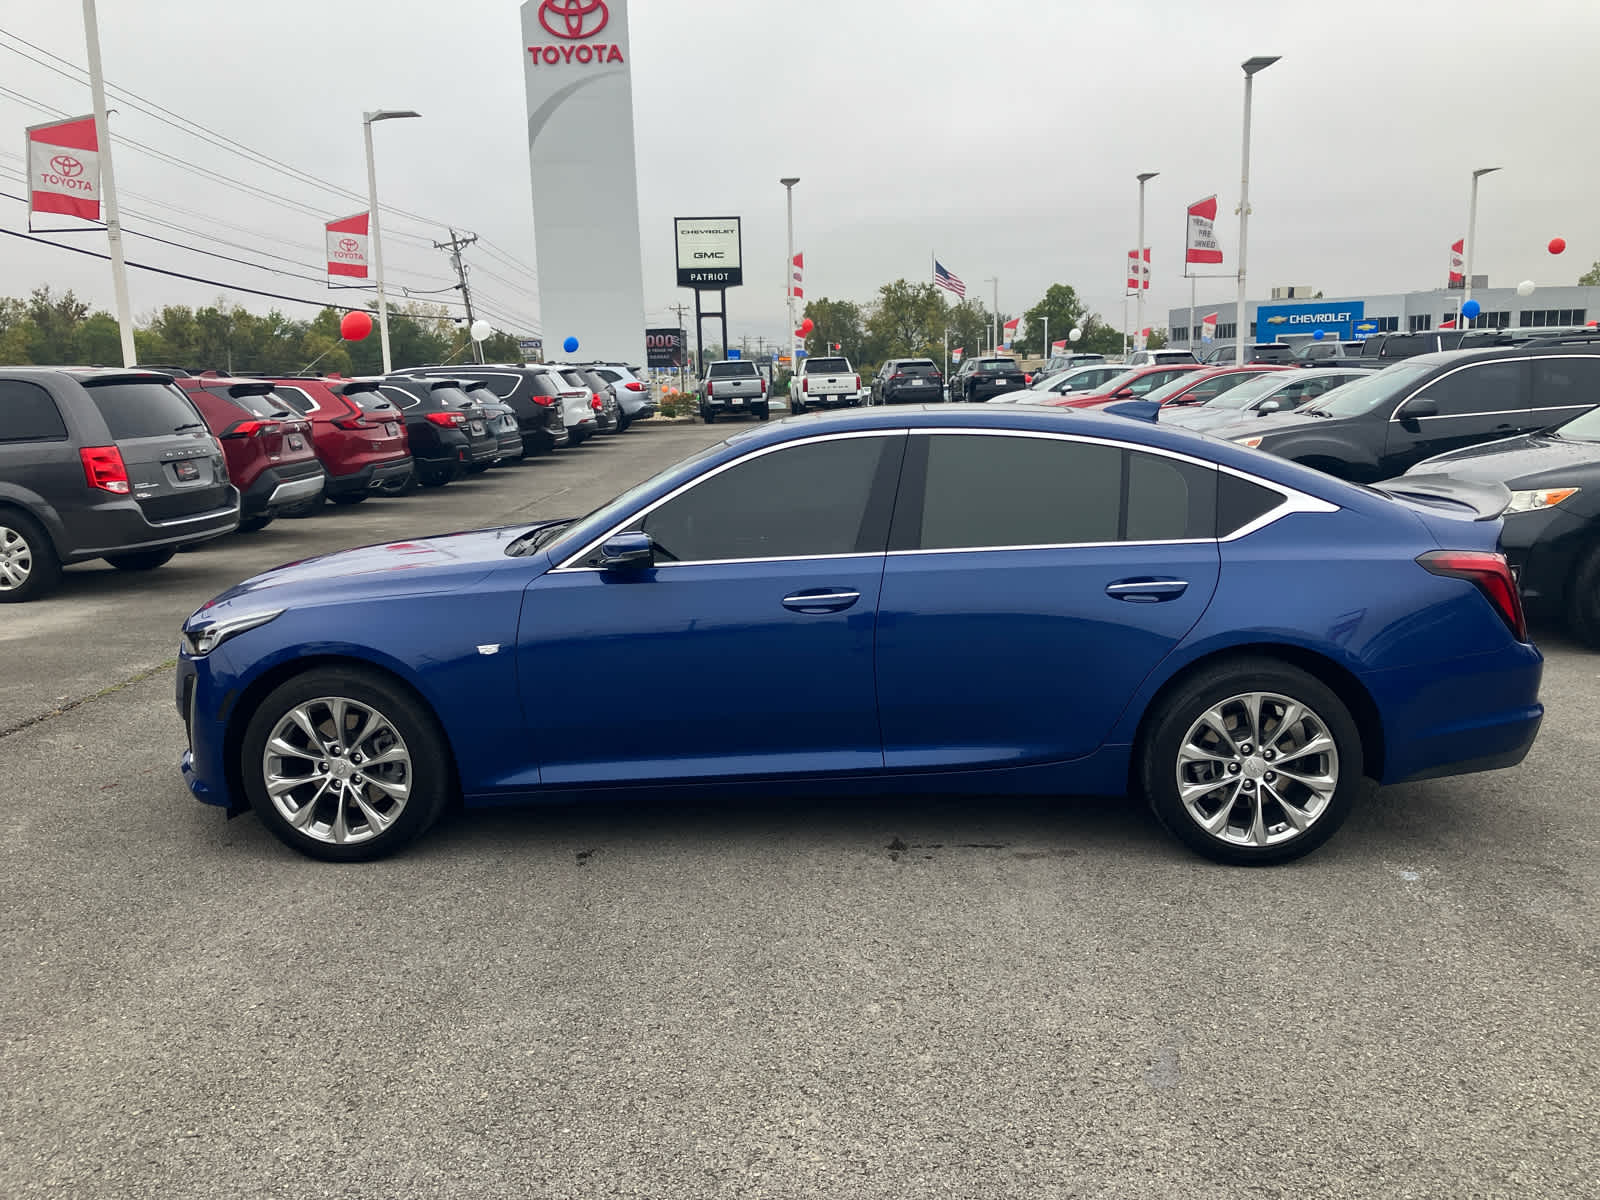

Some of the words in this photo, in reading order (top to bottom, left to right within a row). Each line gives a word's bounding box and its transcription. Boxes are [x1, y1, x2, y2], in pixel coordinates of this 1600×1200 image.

[527, 44, 624, 65] TOYOTA
[40, 173, 93, 192] TOYOTA
[333, 251, 364, 260] TOYOTA
[694, 251, 725, 259] GMC
[690, 272, 729, 281] PATRIOT
[1289, 312, 1352, 324] CHEVROLET
